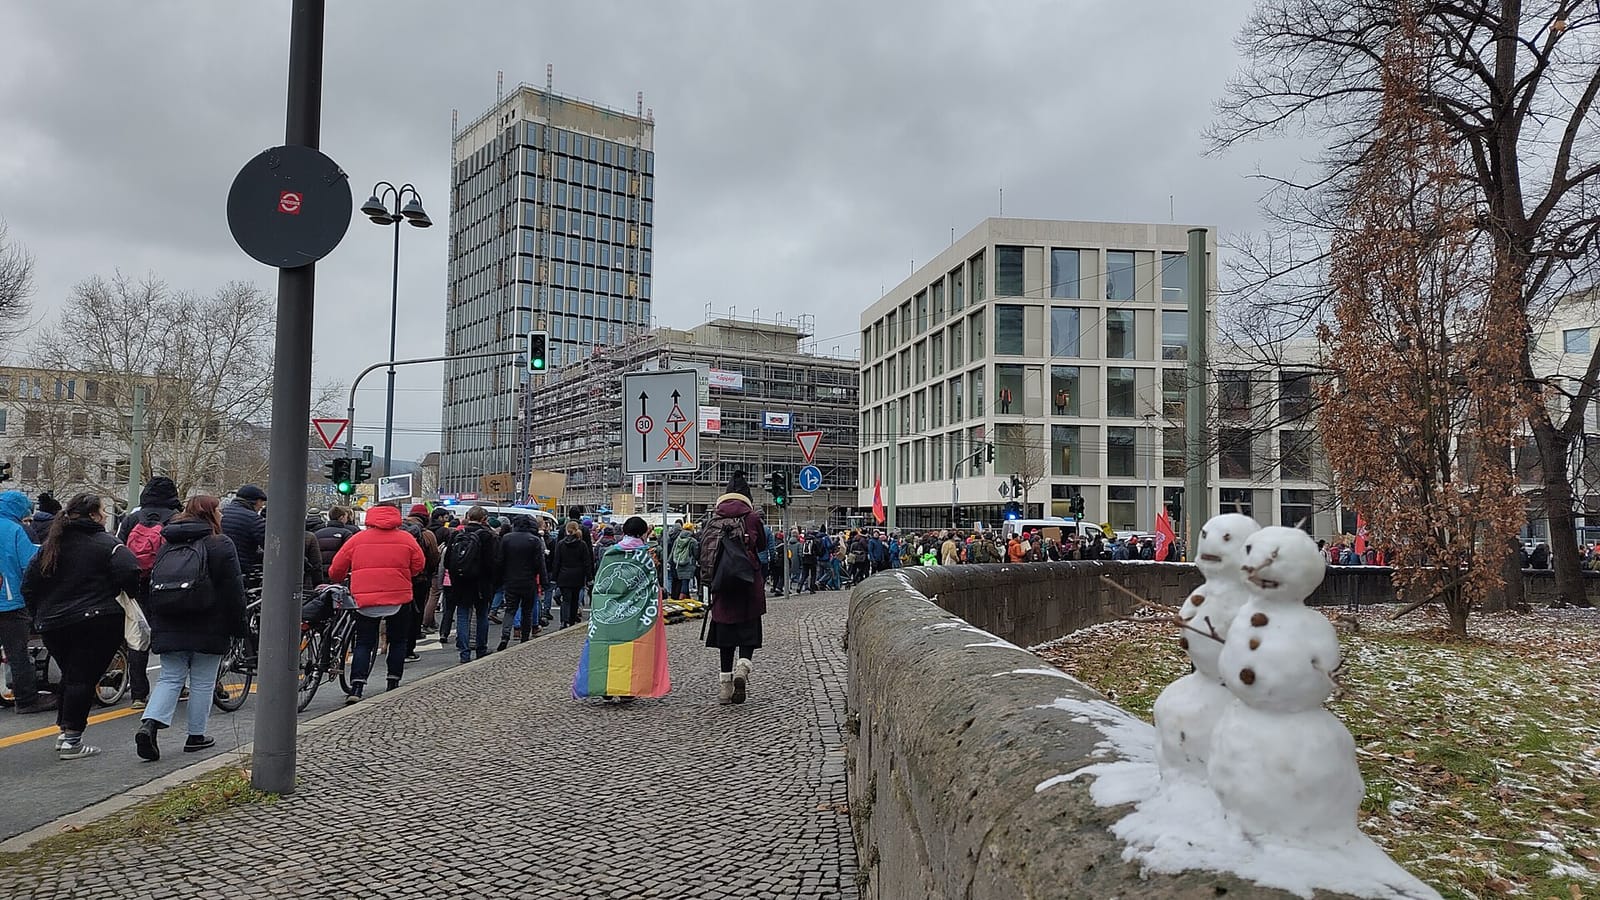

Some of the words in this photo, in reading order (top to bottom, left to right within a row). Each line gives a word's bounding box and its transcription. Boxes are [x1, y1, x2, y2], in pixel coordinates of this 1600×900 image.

[638, 420, 650, 430] 30
[624, 549, 659, 593] FRIDYS
[640, 598, 658, 626] FOR
